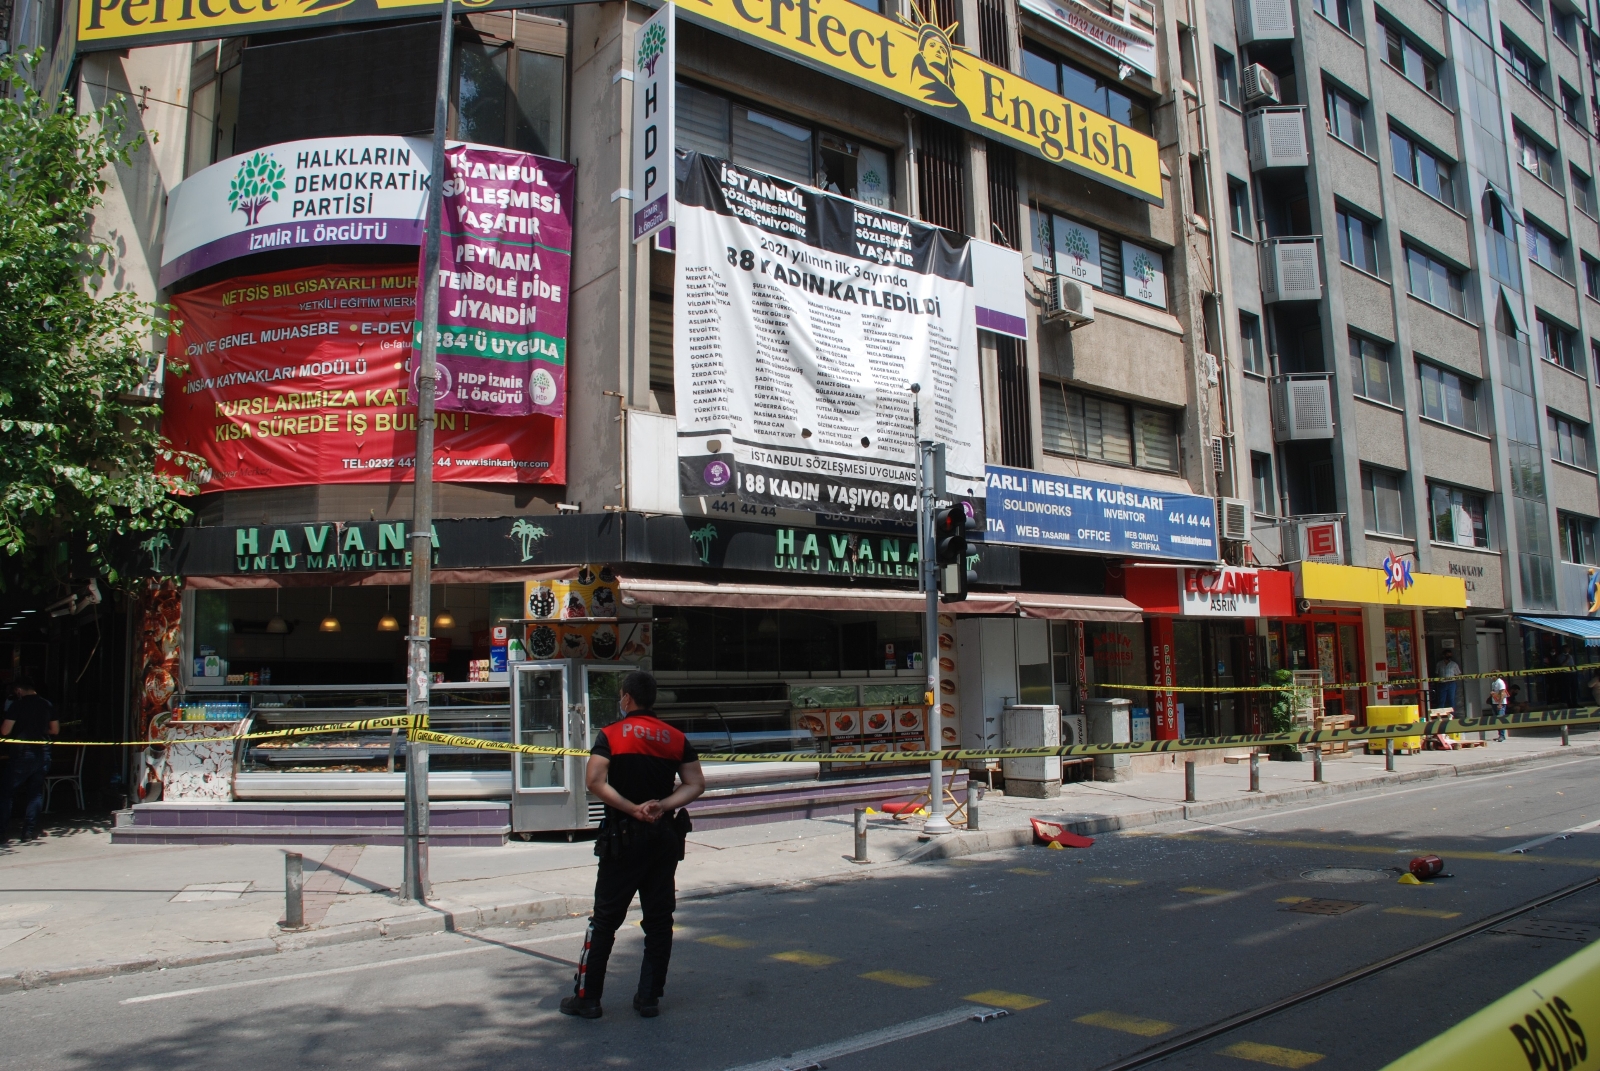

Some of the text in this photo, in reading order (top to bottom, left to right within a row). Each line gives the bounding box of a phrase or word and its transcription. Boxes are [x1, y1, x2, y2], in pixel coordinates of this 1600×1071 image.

[1089, 27, 1104, 43] 441
[1106, 34, 1116, 47] 40
[698, 0, 1137, 179] erfect English
[644, 82, 658, 202] HDP
[296, 148, 411, 171] HALKLARIN
[294, 173, 432, 195] DEMOKRATİK
[720, 163, 807, 211] İSTANBUL
[292, 193, 374, 219] PARTİSİ
[721, 187, 806, 224] SÖZLEŞMESİNDEN
[456, 205, 540, 235] YAŞATIR
[853, 209, 912, 238] İSTANBUL
[249, 222, 388, 251] İZMİR İL ÖRGÜTÜ
[855, 228, 912, 250] SÖZLEŞMESİ
[456, 244, 542, 272] PEYMANA
[760, 237, 788, 258] 2021
[835, 261, 851, 275] ilk
[854, 265, 861, 278] 3
[863, 270, 907, 287] ayında
[855, 242, 914, 267] YAŞATIR
[1071, 265, 1087, 278] HDP
[222, 284, 270, 307] NETSİS
[521, 274, 561, 302] DİDE
[760, 257, 825, 297] KADIN
[829, 277, 942, 318] KATLEDİLDİ
[1138, 288, 1153, 300] HDP
[299, 297, 338, 311] YETKİLİ
[340, 297, 380, 309] EĞİTİM
[449, 294, 537, 326] JİYANDİN
[218, 332, 257, 350] GENEL
[260, 322, 339, 344] MUHASEBE
[361, 322, 414, 335] E-DEV
[380, 340, 413, 351] (e-fatu
[491, 338, 560, 359] UYGULA
[187, 358, 367, 395] İNSAN KAYNAKLARI MODÜLÜ
[458, 372, 524, 389] HDP İZMİR
[215, 392, 359, 417] KURSLARIMIZA
[365, 389, 418, 407] KAT
[457, 385, 469, 400] İL
[471, 386, 523, 404] ÖRGÜTÜ
[215, 421, 252, 442] KISA
[258, 411, 339, 438] SÜREDE
[346, 410, 368, 436] İŞ
[342, 458, 395, 469] TEL:0232
[437, 458, 451, 467] 44
[751, 449, 803, 467] İSTANBUL
[805, 456, 868, 475] SÖZLEŞMESİ
[745, 473, 765, 494] 88
[768, 477, 820, 501] KADIN
[826, 484, 889, 512] YAŞIYOR
[1032, 478, 1093, 501] MESLEK
[1096, 488, 1163, 511] KURSLARI
[712, 500, 777, 517] 441 44 44
[1004, 499, 1146, 523] SOLIDWORKS INVENTOR
[1168, 512, 1211, 528] 441 44 44
[1015, 525, 1040, 538] WEB
[1042, 530, 1070, 541] TASARIM
[1077, 528, 1111, 542] OFFICE
[1124, 530, 1159, 542] MEB ONAYLI
[237, 554, 297, 571] UNLU
[774, 555, 820, 571] UNLU
[1184, 568, 1260, 595] ECZANE
[1210, 600, 1237, 611] ASRIN
[1153, 645, 1164, 726] ECZANE
[622, 723, 671, 744] POLİS
